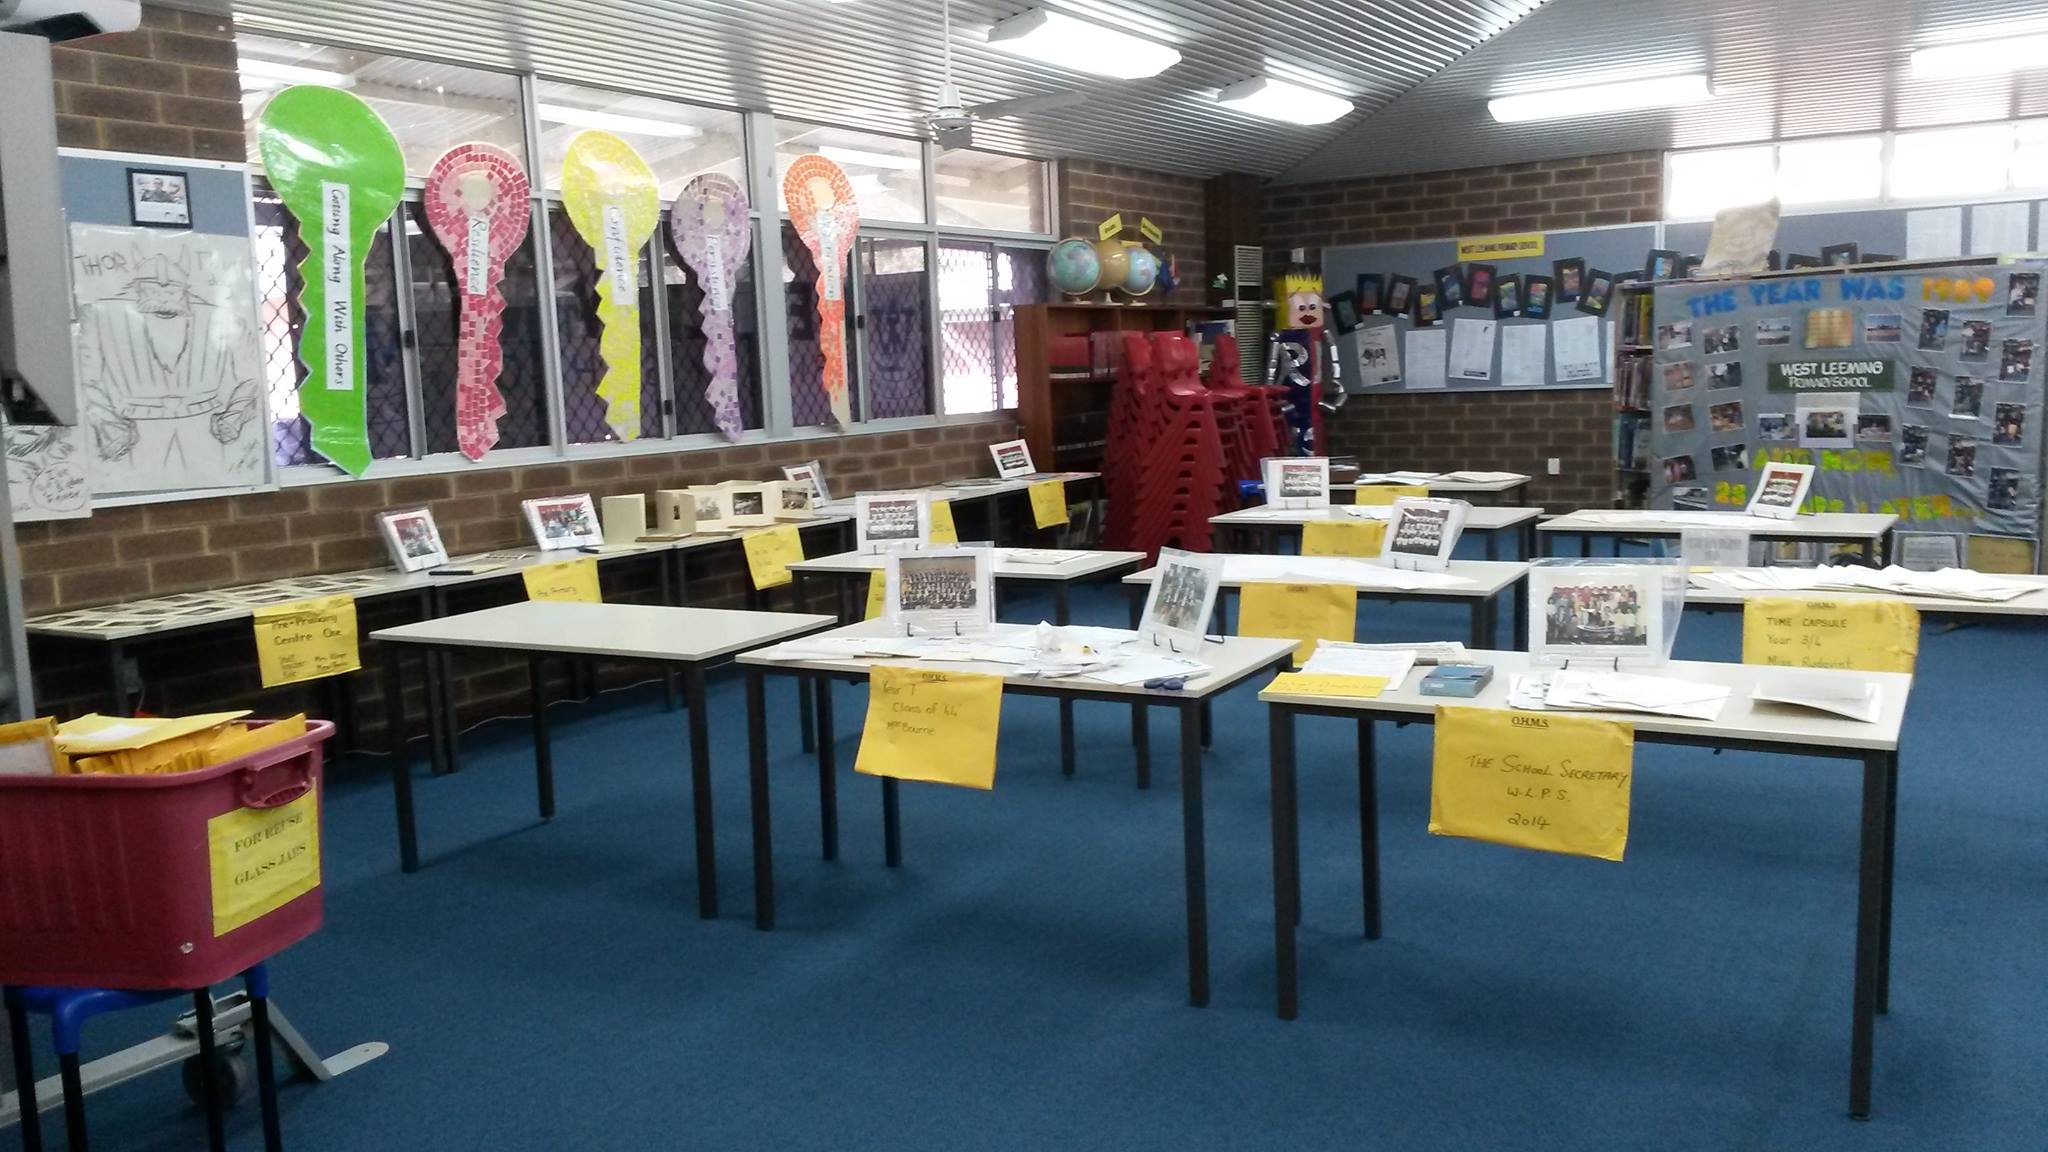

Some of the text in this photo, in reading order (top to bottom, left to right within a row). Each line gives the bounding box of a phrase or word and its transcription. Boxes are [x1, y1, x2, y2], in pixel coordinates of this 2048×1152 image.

[74, 250, 130, 277] THOR
[328, 245, 346, 284] Along
[469, 218, 487, 293] Resilience
[1687, 276, 1996, 318] THE YEAR WAS 1989
[333, 300, 347, 334] With
[334, 343, 348, 385] Others
[1780, 361, 1884, 376] WEST LEEMING
[1831, 376, 1872, 388] SCHOOL
[1765, 617, 1848, 629] TIME CAPSULE
[273, 632, 313, 646] Centre
[1767, 634, 1791, 645] Year
[882, 680, 902, 695] Year
[892, 702, 922, 714] Class
[925, 702, 938, 715] of
[1464, 753, 1495, 769] THE
[1507, 812, 1551, 830] 2014
[234, 832, 262, 853] FOR
[234, 842, 307, 886] GLASS JARS
